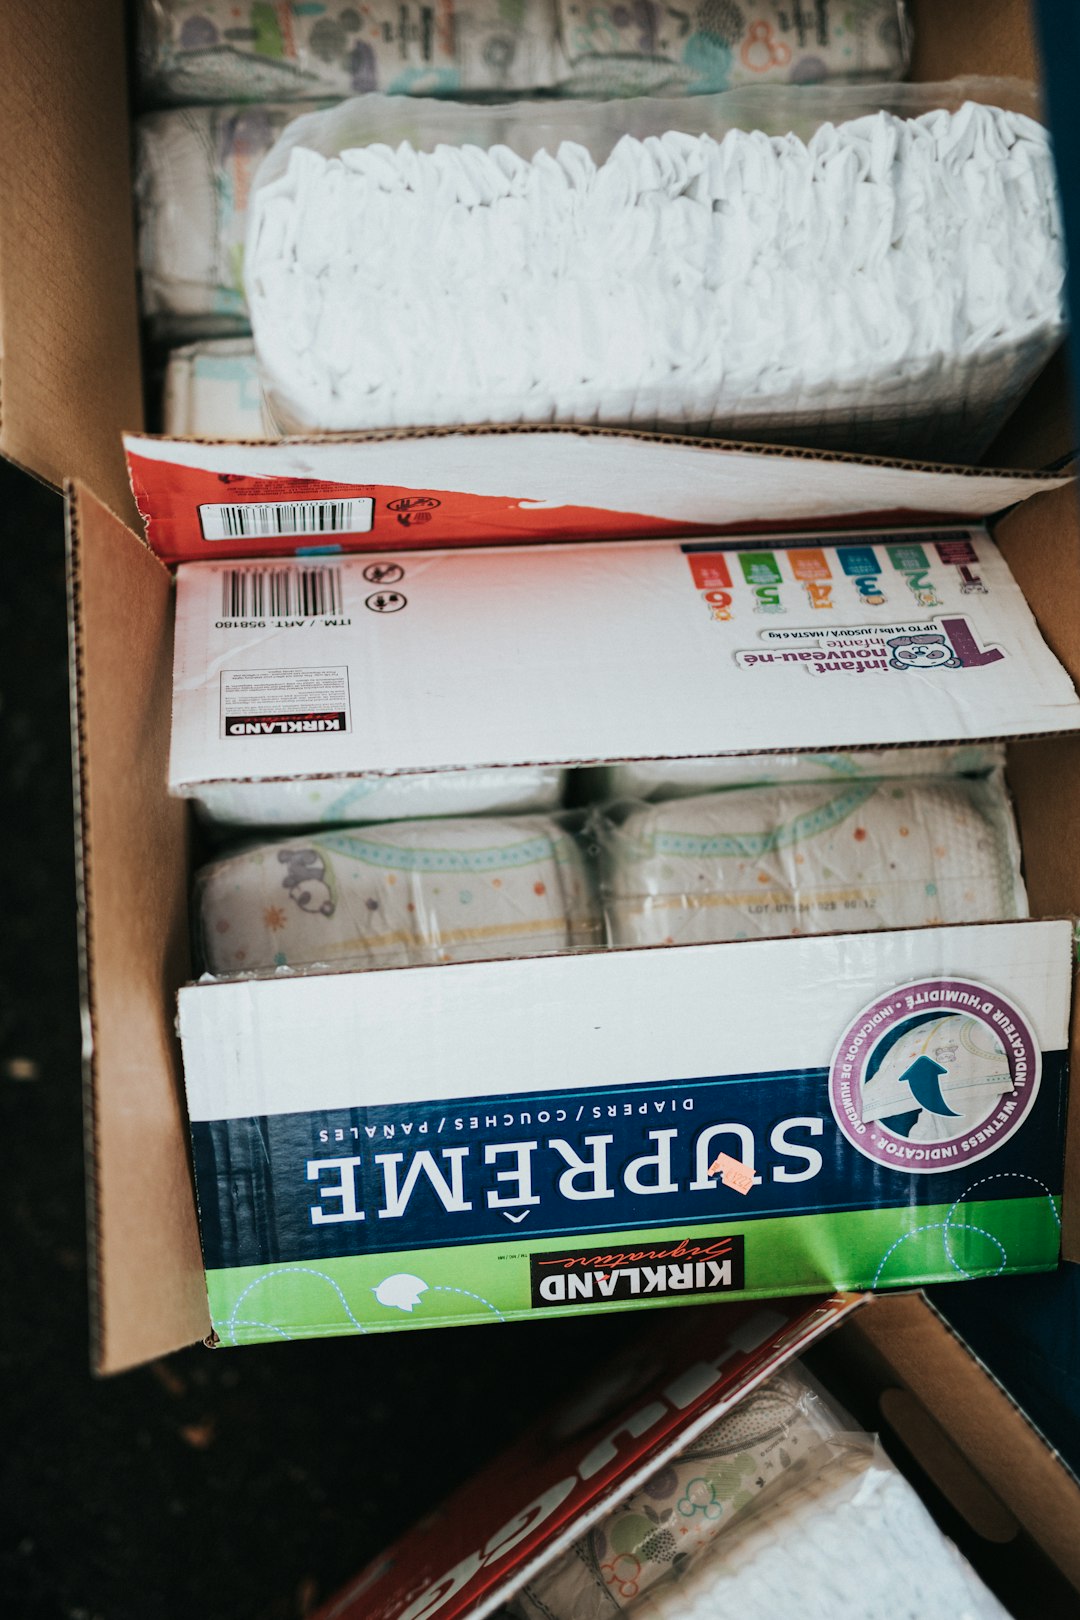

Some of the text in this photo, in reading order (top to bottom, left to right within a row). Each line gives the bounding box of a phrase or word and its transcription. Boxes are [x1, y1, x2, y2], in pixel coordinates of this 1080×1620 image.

[855, 577, 882, 596] 3
[904, 572, 934, 590] 2
[705, 591, 732, 609] 6
[756, 586, 780, 604] 5
[806, 584, 832, 608] 4
[270, 620, 304, 628] ART.
[768, 632, 781, 640] kg
[791, 631, 824, 639] HASTA
[826, 638, 886, 648] infante
[940, 618, 1005, 668] 1
[744, 648, 888, 666] nouveau-né
[813, 659, 889, 674] infant
[229, 720, 340, 734] KIRKLAND
[905, 989, 1027, 1087] INDICATEUR D'HUMIDITÉ
[840, 1004, 894, 1135] INDICADOR DE HUMEDAD
[877, 1100, 1018, 1160] WETNESS INDICATOR
[305, 1116, 824, 1225] SUPRÊME
[538, 1238, 732, 1268] Signature
[539, 1260, 732, 1301] KIRKLAND
